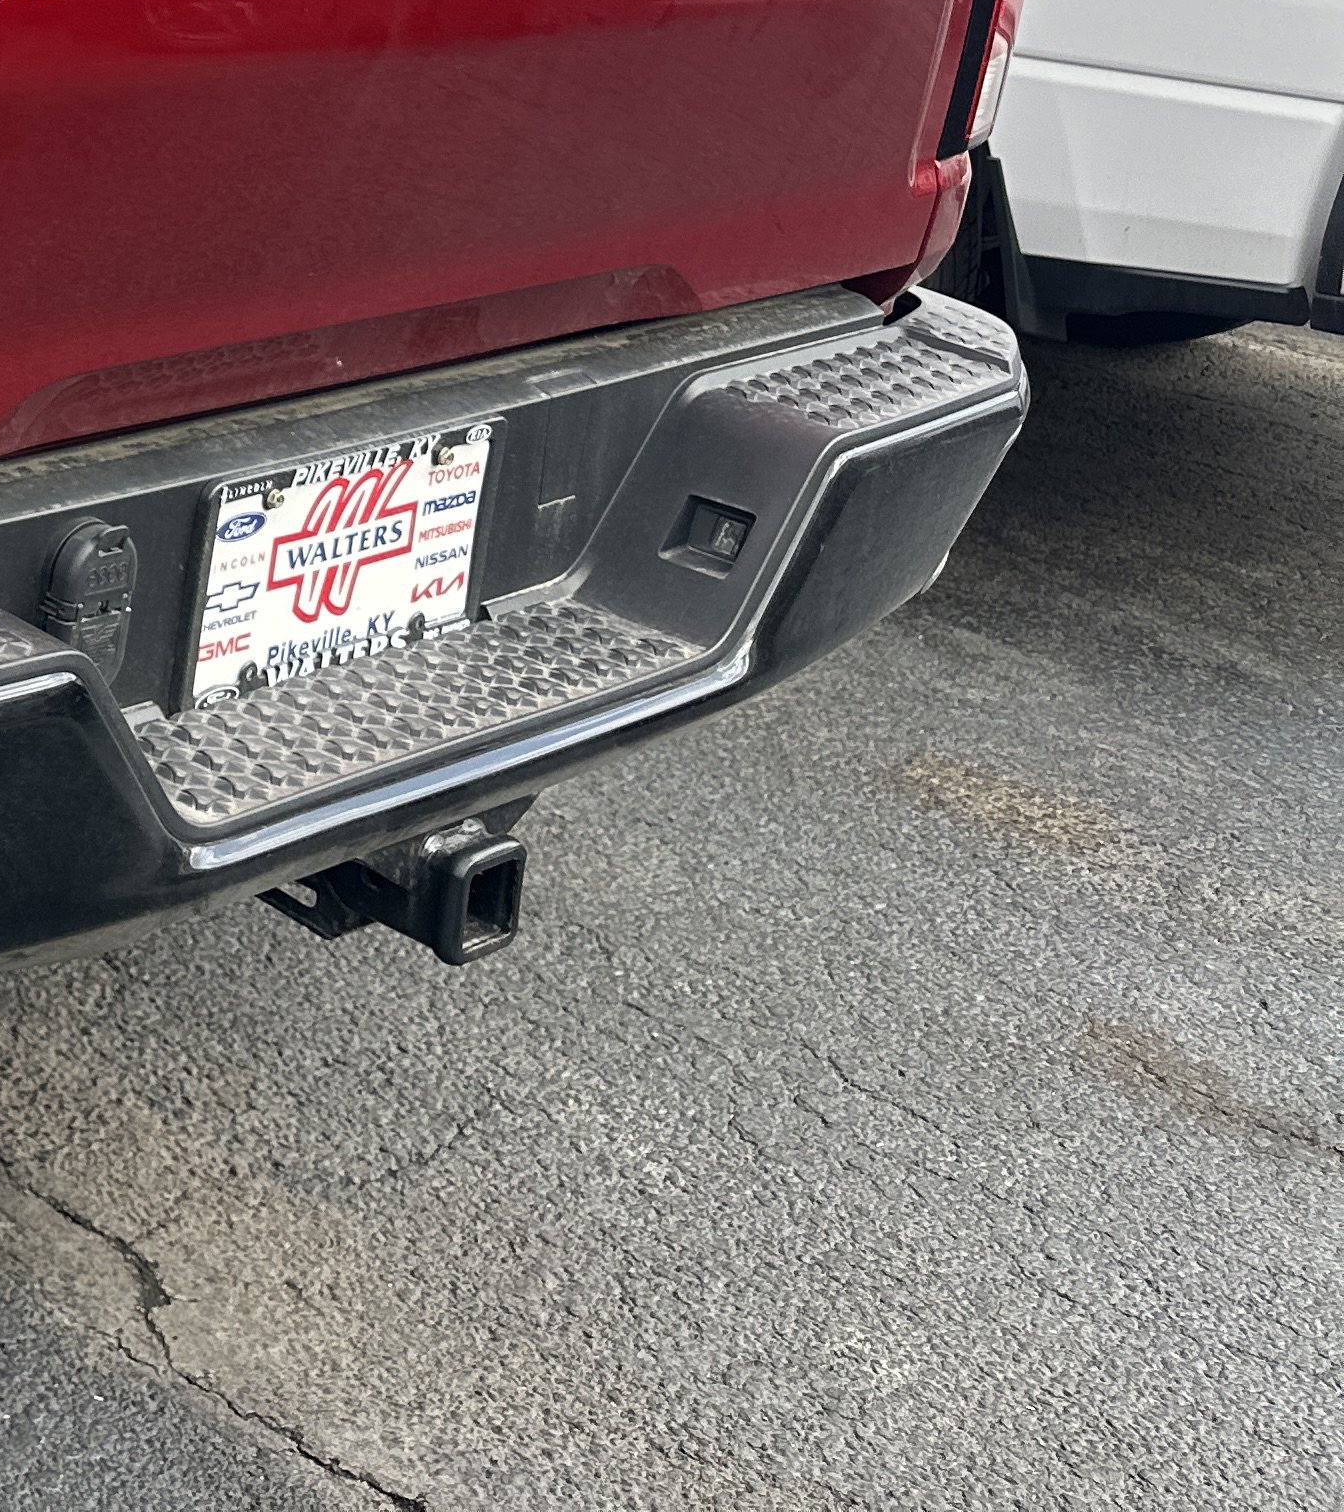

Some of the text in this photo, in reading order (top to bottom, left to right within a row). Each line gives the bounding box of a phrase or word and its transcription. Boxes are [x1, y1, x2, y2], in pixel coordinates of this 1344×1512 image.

[409, 433, 441, 461] KY
[428, 461, 481, 486] TOYOTA
[422, 490, 477, 516] mazda
[418, 518, 473, 543] MITSUBISHI
[287, 520, 404, 570] WALTERS
[414, 544, 469, 570] NISSAN
[213, 551, 266, 575] INCOLN
[202, 610, 258, 632] HEVROLET
[367, 609, 396, 637] KY
[197, 632, 252, 662] GMC
